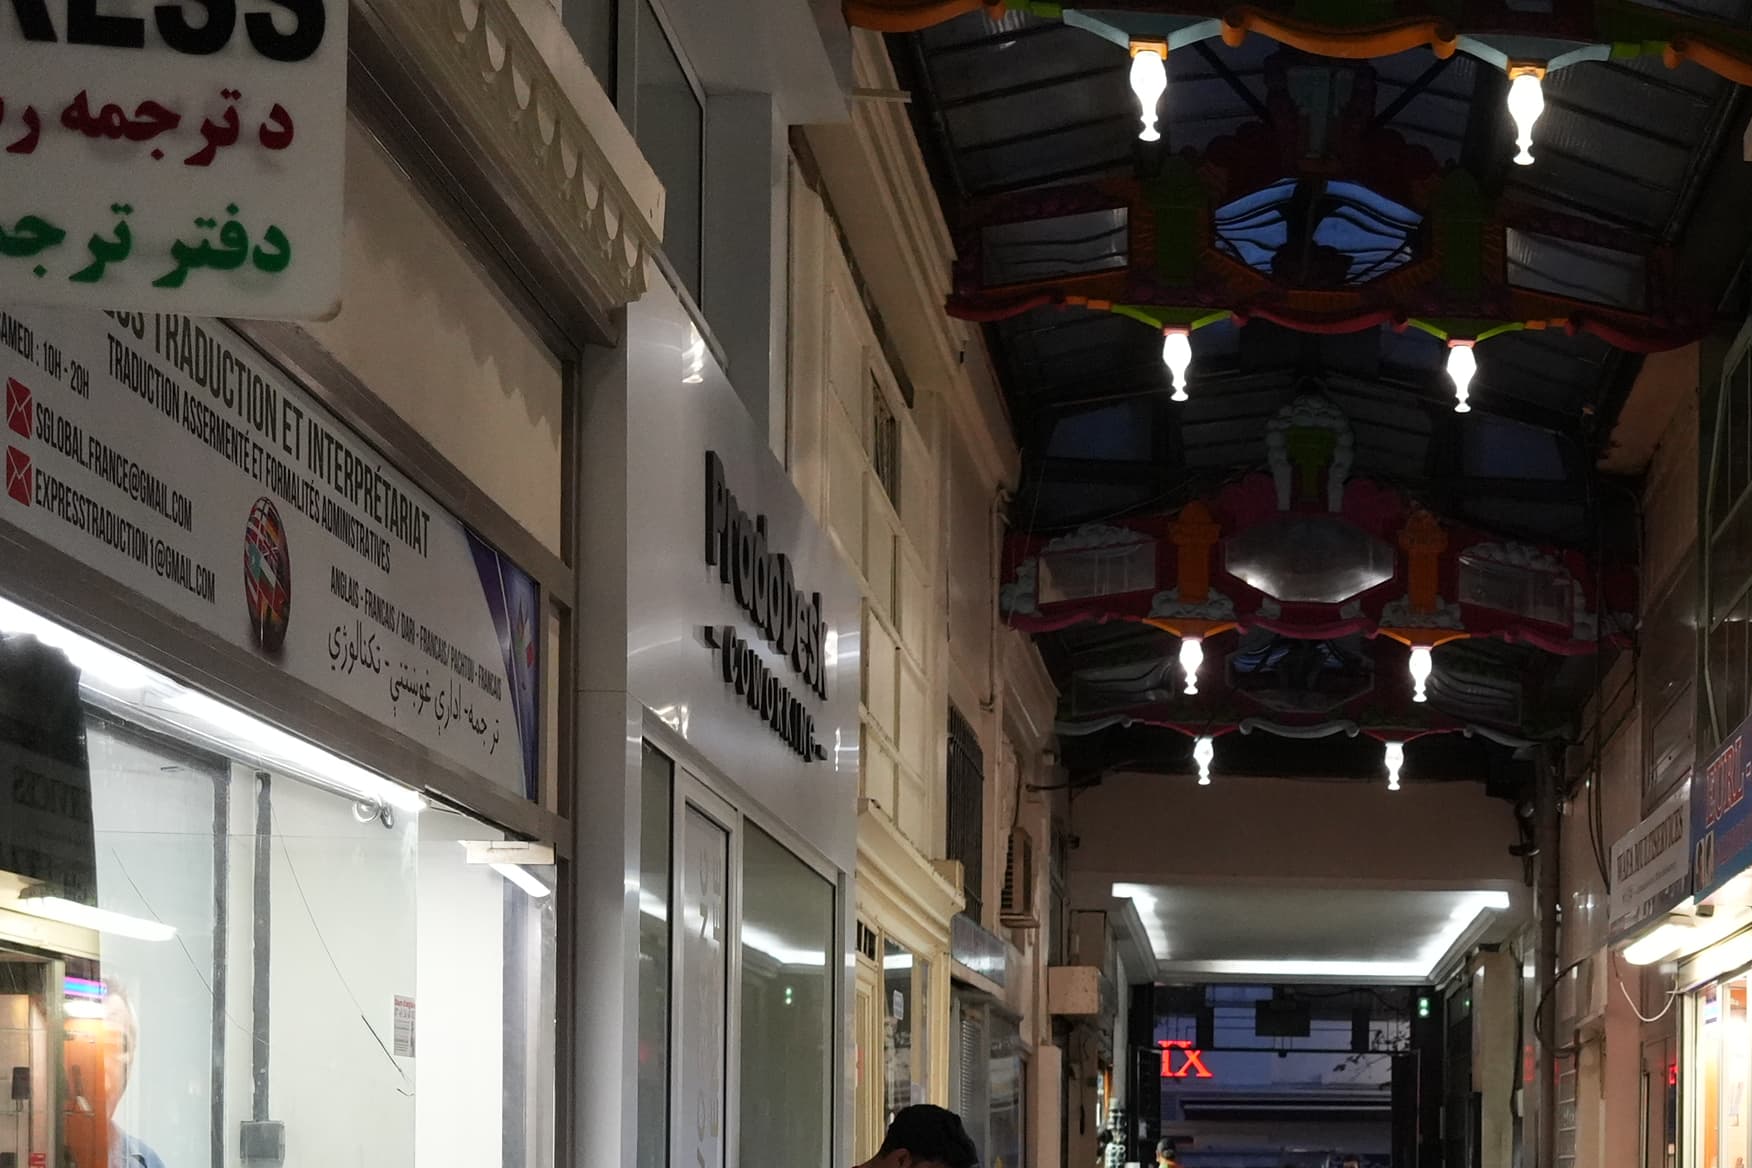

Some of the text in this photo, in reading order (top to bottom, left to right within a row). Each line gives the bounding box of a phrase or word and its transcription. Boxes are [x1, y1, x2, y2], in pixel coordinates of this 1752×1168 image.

[152, 202, 290, 288] دفتر
[43, 341, 62, 382] 10H
[70, 360, 89, 400] 20H
[154, 313, 430, 558] TRADUCTION ET INTERPRÉTARIAT
[35, 403, 193, 533] SGLOBAL.FRANCE@GMAIL.COM
[107, 332, 391, 575] TRADUCTION ASSERMENTÉ ET FORMALITÉS ADMINISTRATIVES
[35, 468, 215, 604] EXPRESSTRADUCTION1@GMAIL.COM
[330, 565, 359, 609] ANGLAIS
[705, 450, 828, 701] PradoDesk
[722, 625, 817, 763] COWORKING
